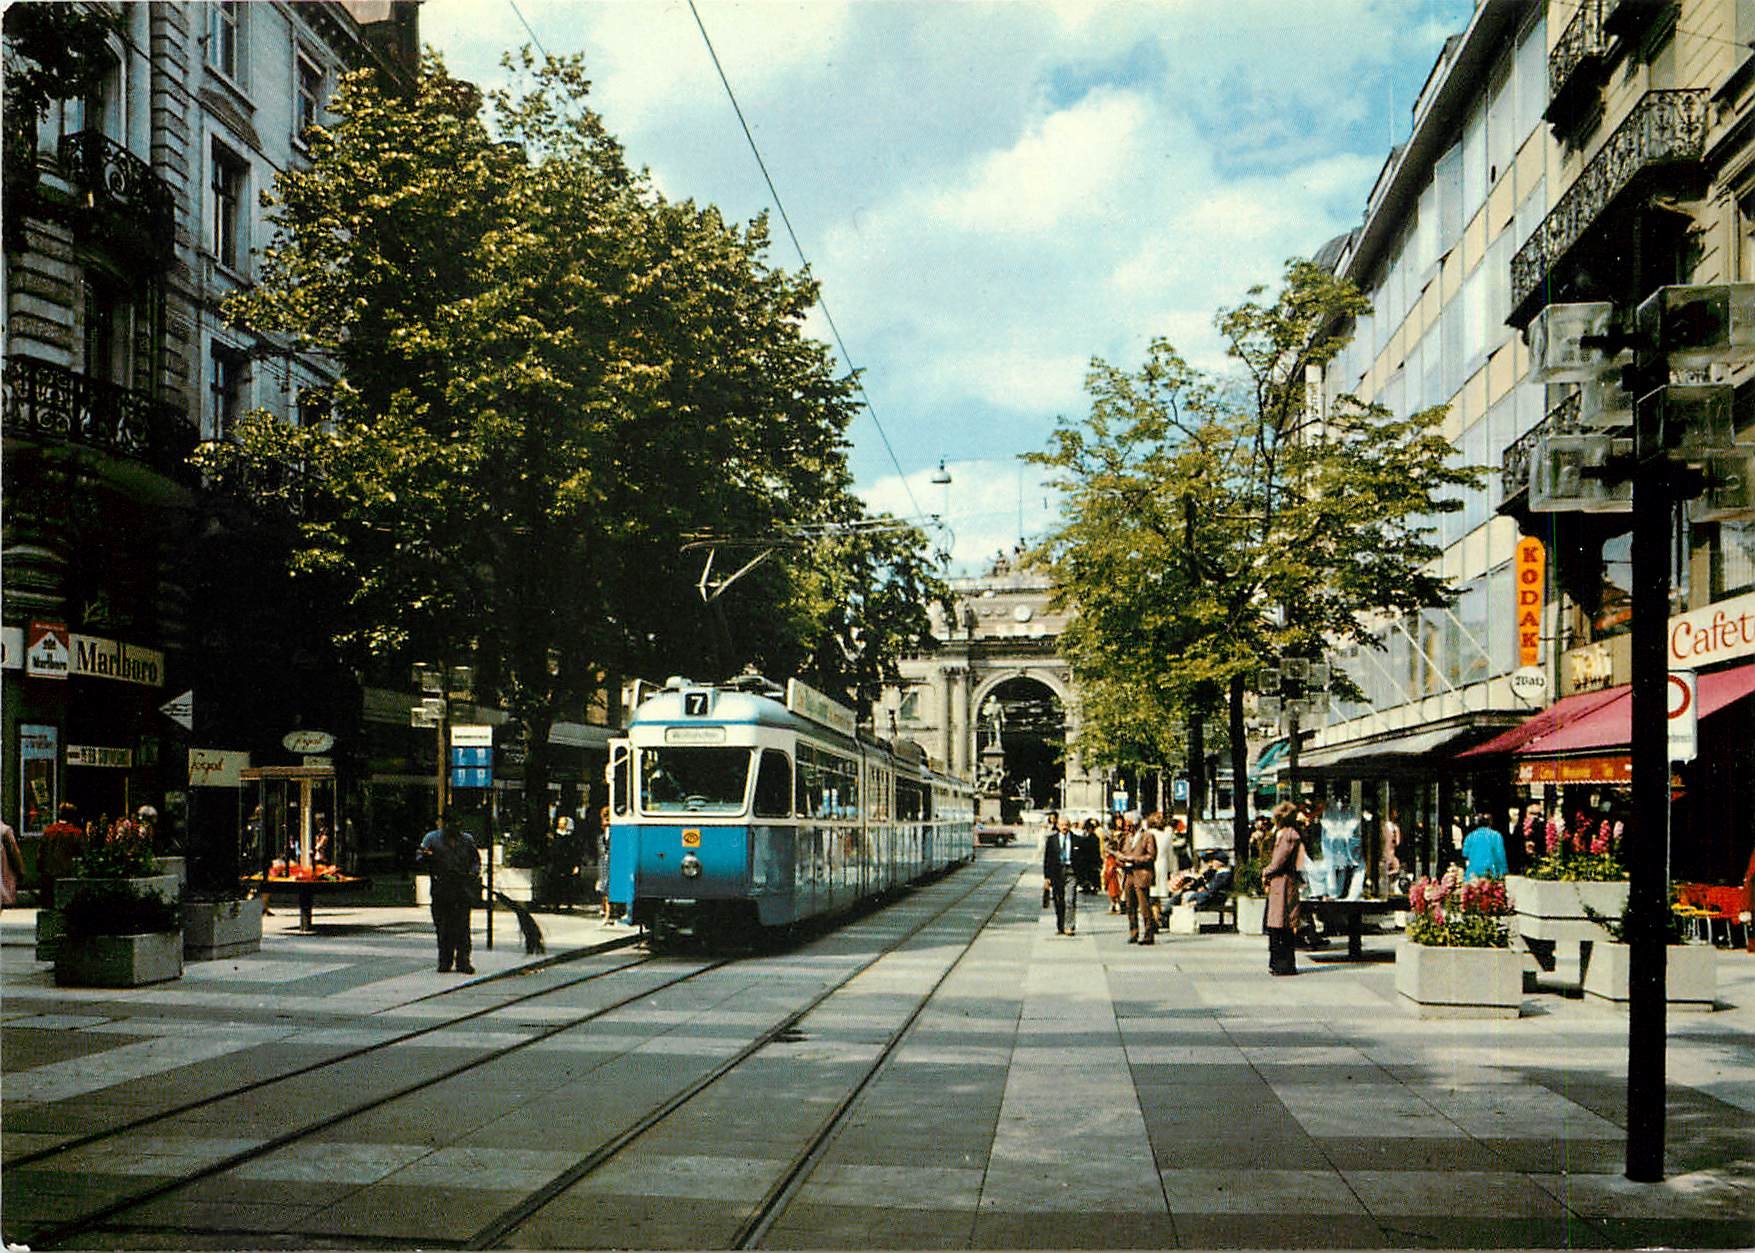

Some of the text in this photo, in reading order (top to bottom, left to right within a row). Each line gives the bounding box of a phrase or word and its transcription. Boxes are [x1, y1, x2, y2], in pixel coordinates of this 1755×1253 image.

[1519, 546, 1539, 648] KODAK
[77, 640, 158, 681] Marlboro
[691, 695, 703, 714] 7
